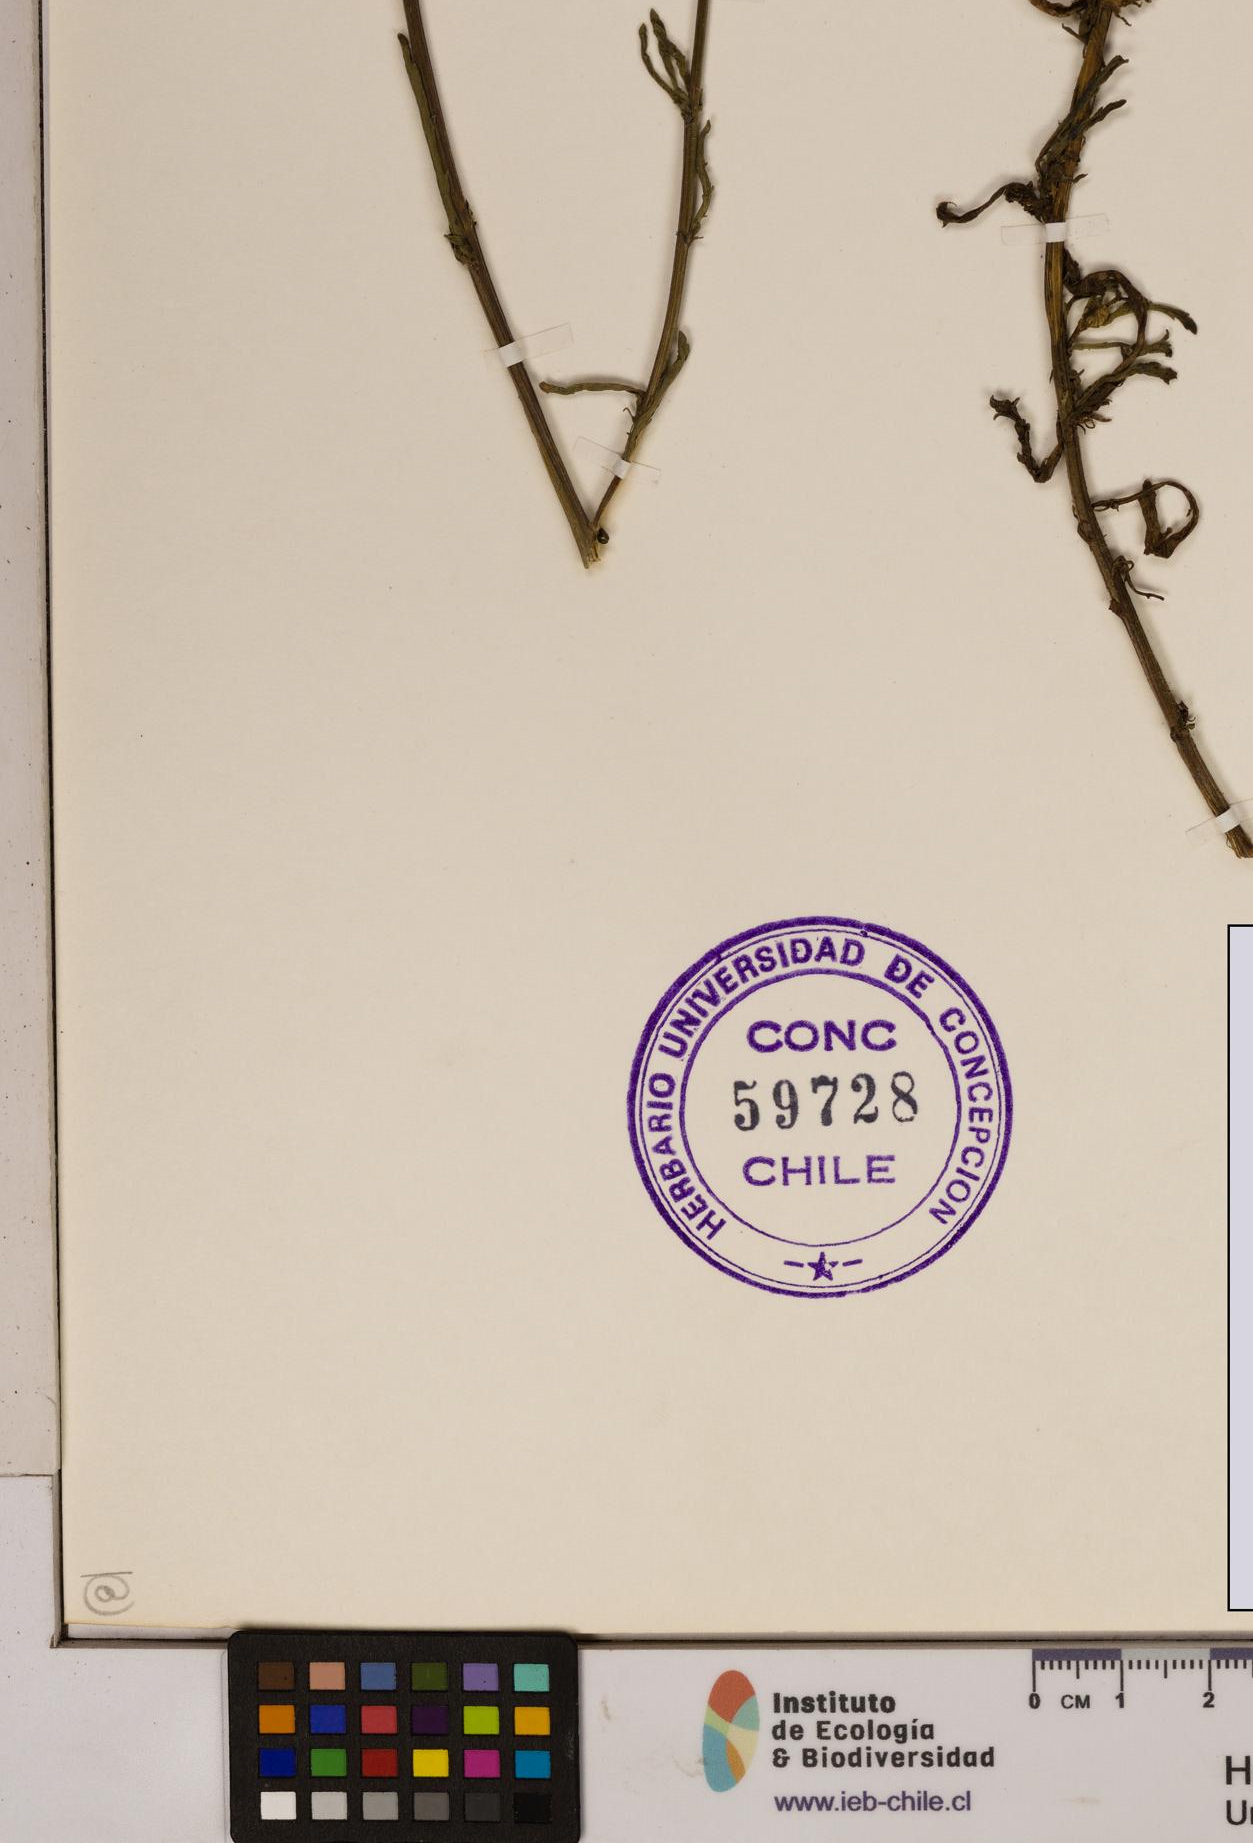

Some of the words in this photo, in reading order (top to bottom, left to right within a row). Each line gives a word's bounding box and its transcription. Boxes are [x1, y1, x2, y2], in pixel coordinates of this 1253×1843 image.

[884, 954, 935, 1000] DE
[658, 936, 867, 1059] UNIVERSIDAD
[747, 1020, 896, 1053] CONC
[734, 1071, 918, 1131] 59728
[928, 1006, 994, 1226] CONCEPCION
[647, 1072, 727, 1240] HERBARIO
[743, 1155, 895, 1186] CHILE
[774, 1691, 896, 1713] Instituto
[1028, 1692, 1041, 1710] 0
[1060, 1694, 1091, 1710] CM
[1114, 1691, 1125, 1709] 1
[1202, 1691, 1215, 1709] 2
[772, 1720, 804, 1740] de
[817, 1719, 934, 1744] Ecología
[773, 1748, 790, 1768] &
[802, 1746, 994, 1768] Biodiversidad
[774, 1791, 970, 1811] www.ieb-chile.cl
